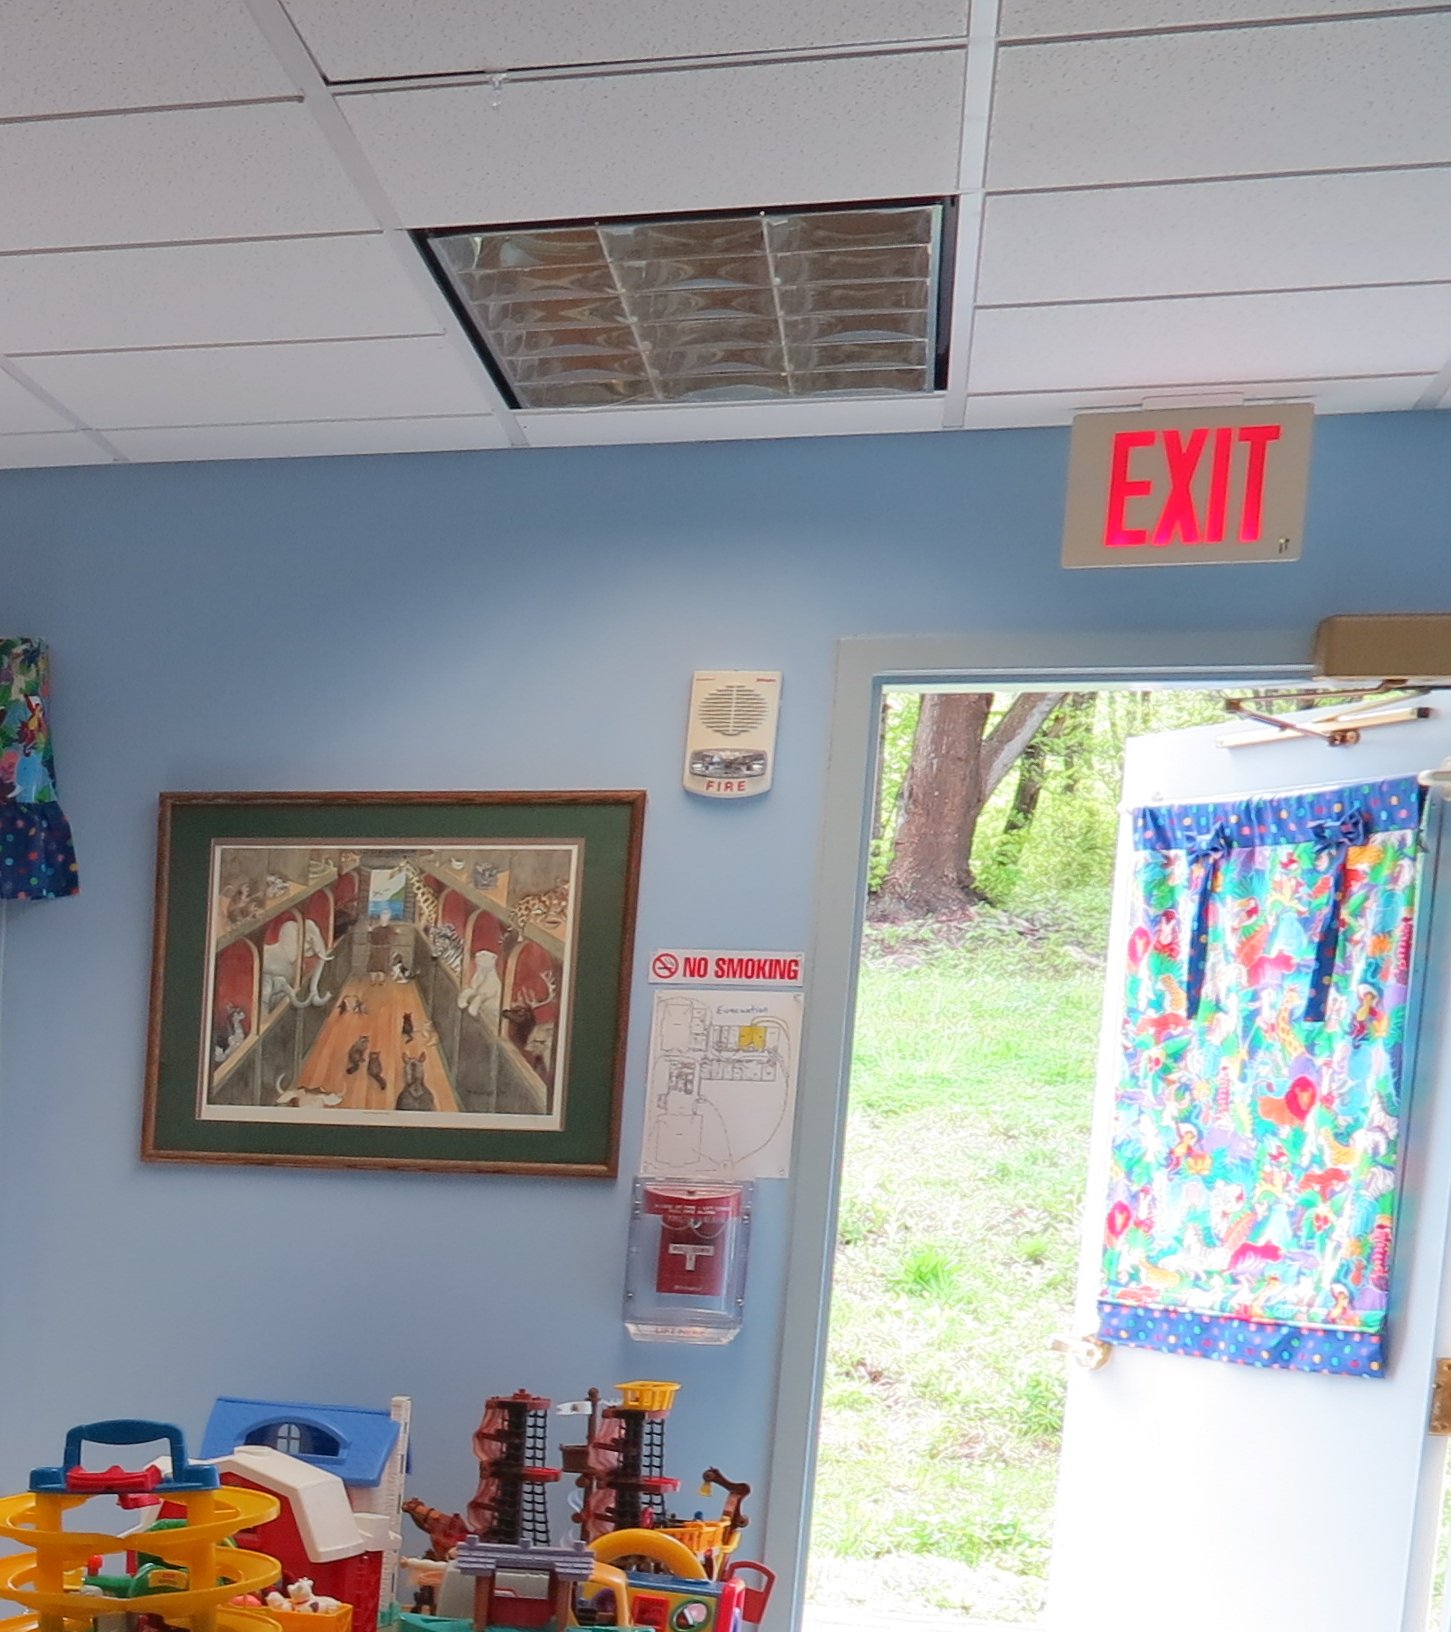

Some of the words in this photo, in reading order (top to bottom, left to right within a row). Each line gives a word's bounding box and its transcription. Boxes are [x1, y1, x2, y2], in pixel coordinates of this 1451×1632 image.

[1103, 424, 1282, 548] EXIT
[705, 780, 747, 792] FIRE
[683, 956, 710, 979] NO
[714, 957, 800, 981] SMOKING
